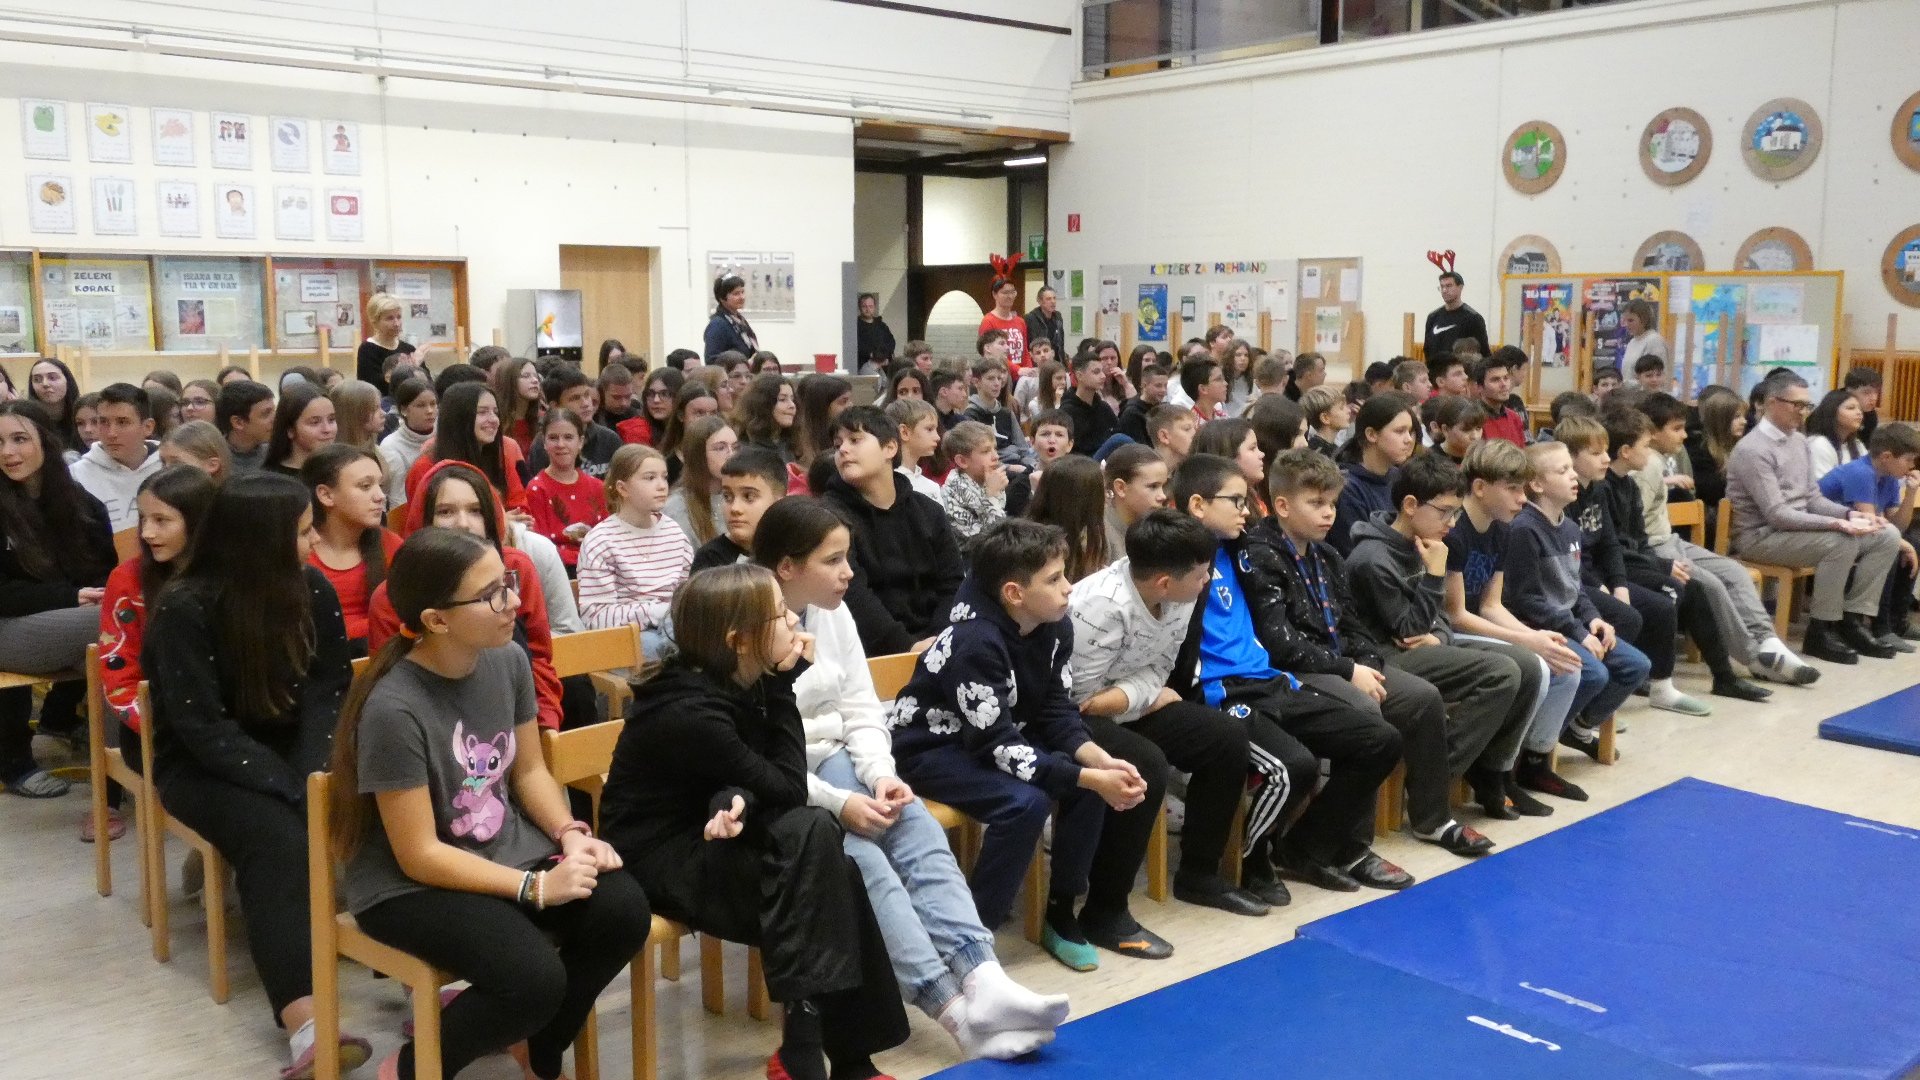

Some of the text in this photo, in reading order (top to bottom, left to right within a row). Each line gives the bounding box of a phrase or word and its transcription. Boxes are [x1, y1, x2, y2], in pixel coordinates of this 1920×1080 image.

[1195, 262, 1208, 275] ZA
[73, 272, 112, 280] ZELENI
[74, 285, 115, 293] KORAKI
